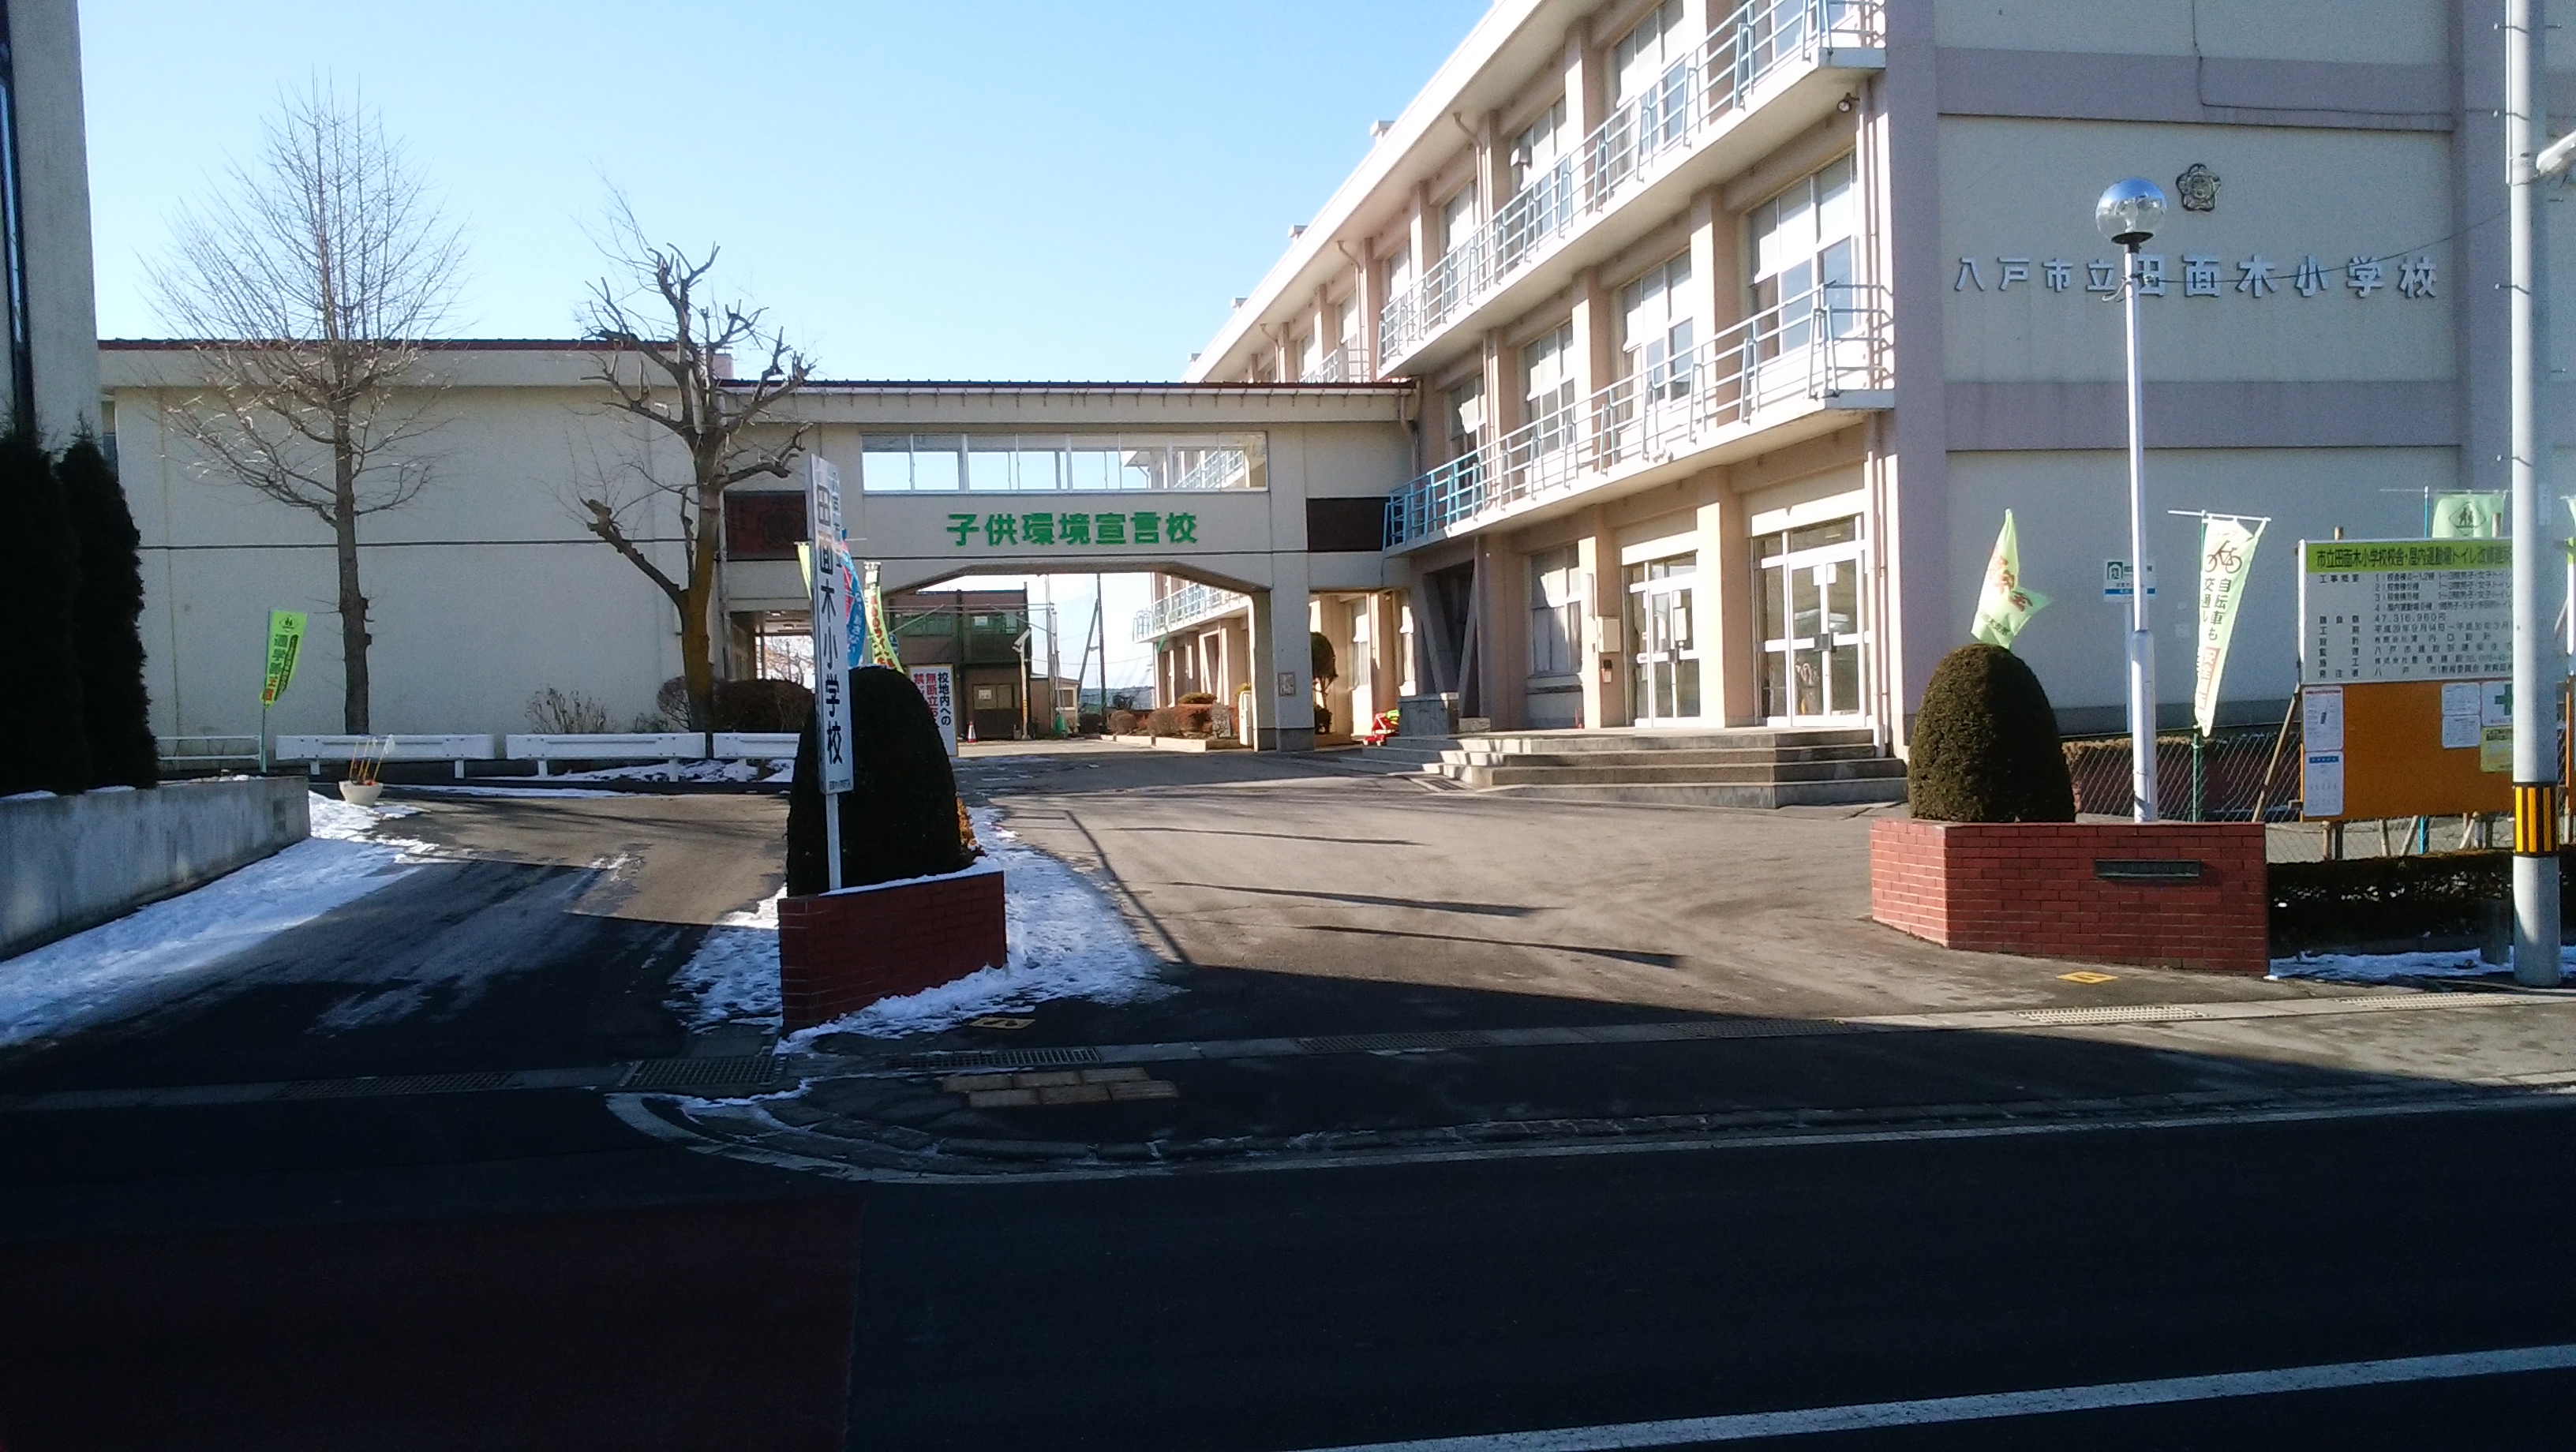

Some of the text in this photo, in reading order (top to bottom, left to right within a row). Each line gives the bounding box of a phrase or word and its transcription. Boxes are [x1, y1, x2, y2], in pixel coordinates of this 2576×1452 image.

[946, 511, 1199, 546] 子供環境宣言校
[817, 483, 843, 765] 田面木小学校
[2207, 578, 2232, 642] 自転車も
[938, 672, 952, 726] 校地内への
